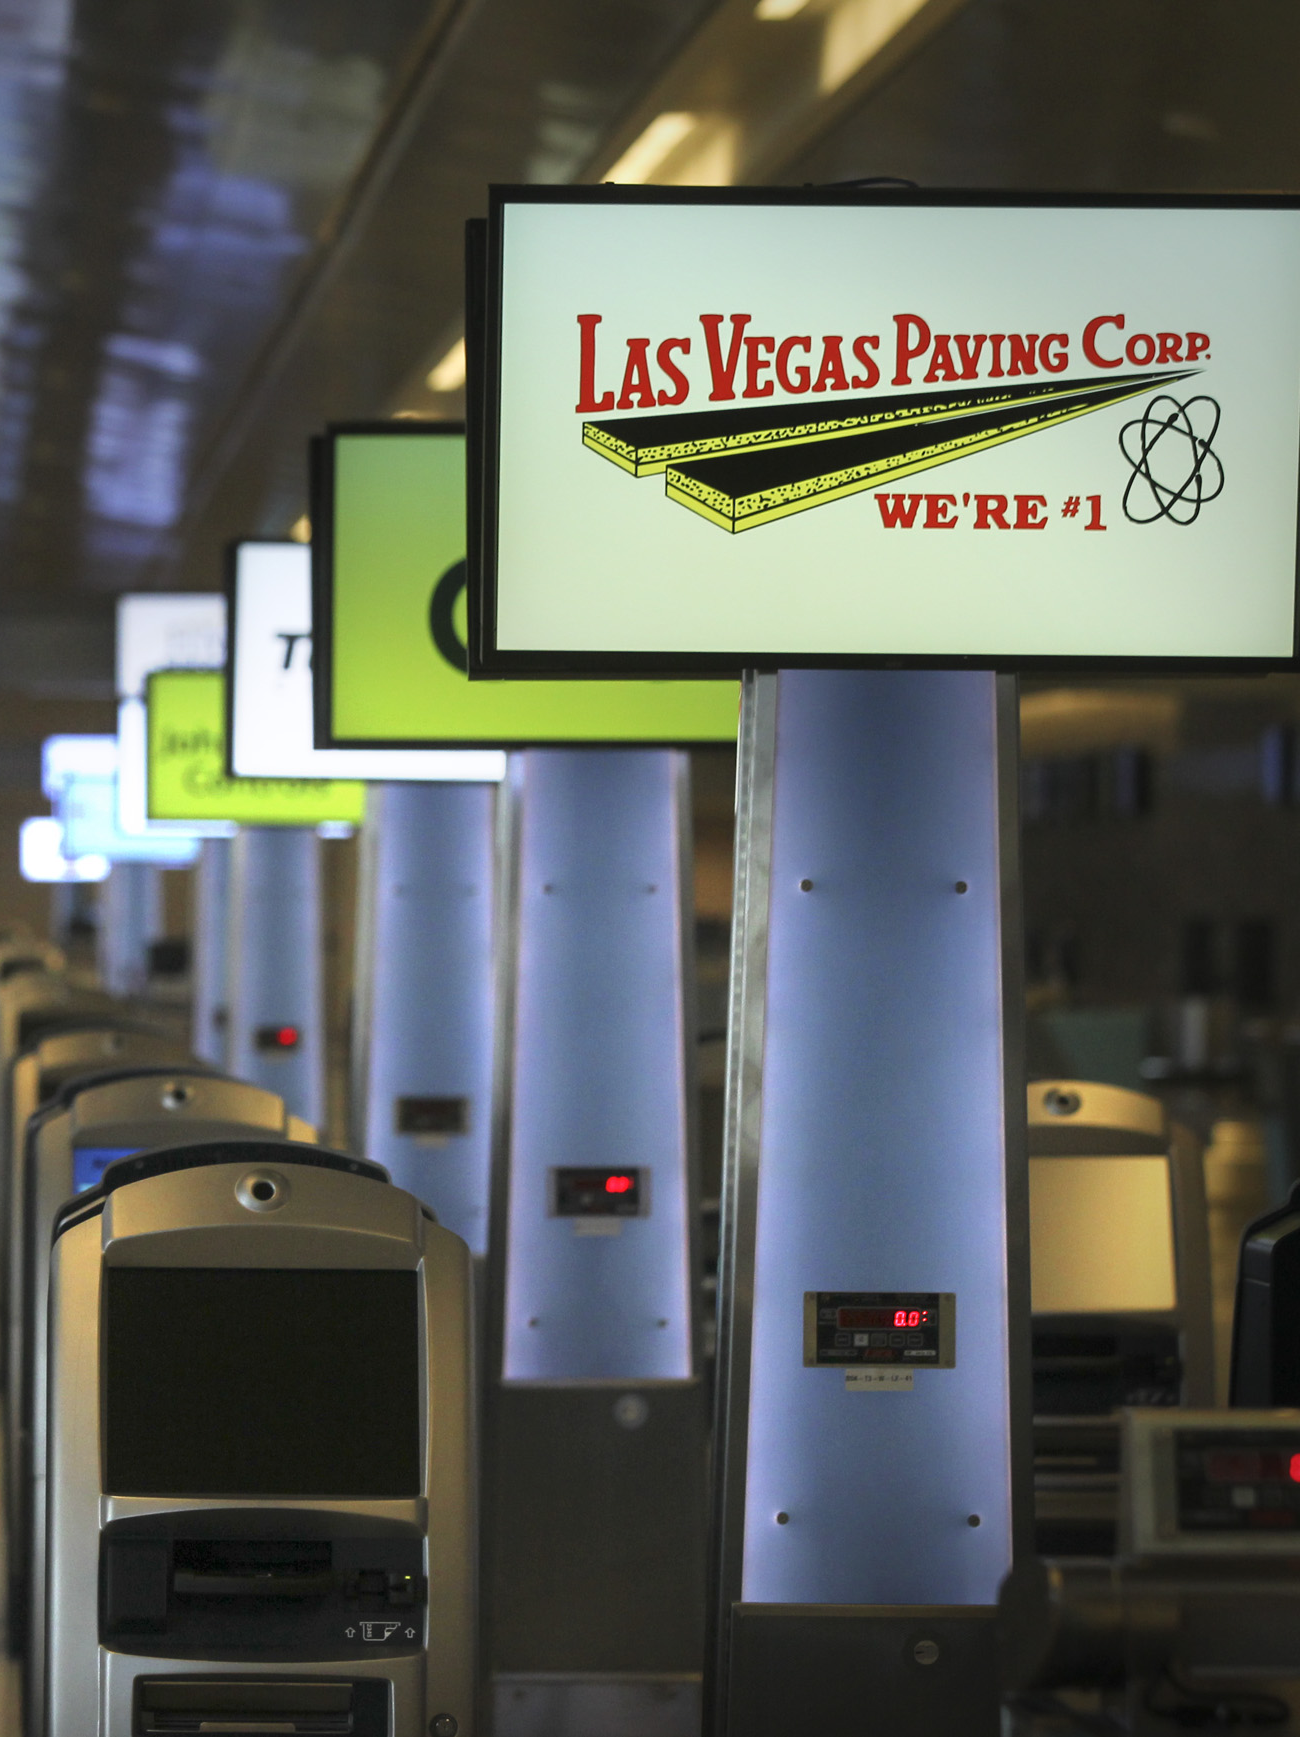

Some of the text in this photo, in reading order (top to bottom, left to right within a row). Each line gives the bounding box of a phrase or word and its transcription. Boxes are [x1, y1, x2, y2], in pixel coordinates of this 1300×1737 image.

[575, 313, 1211, 413] LAS VEGAS PAVING CORP.
[874, 492, 1108, 532] WE'RE #1
